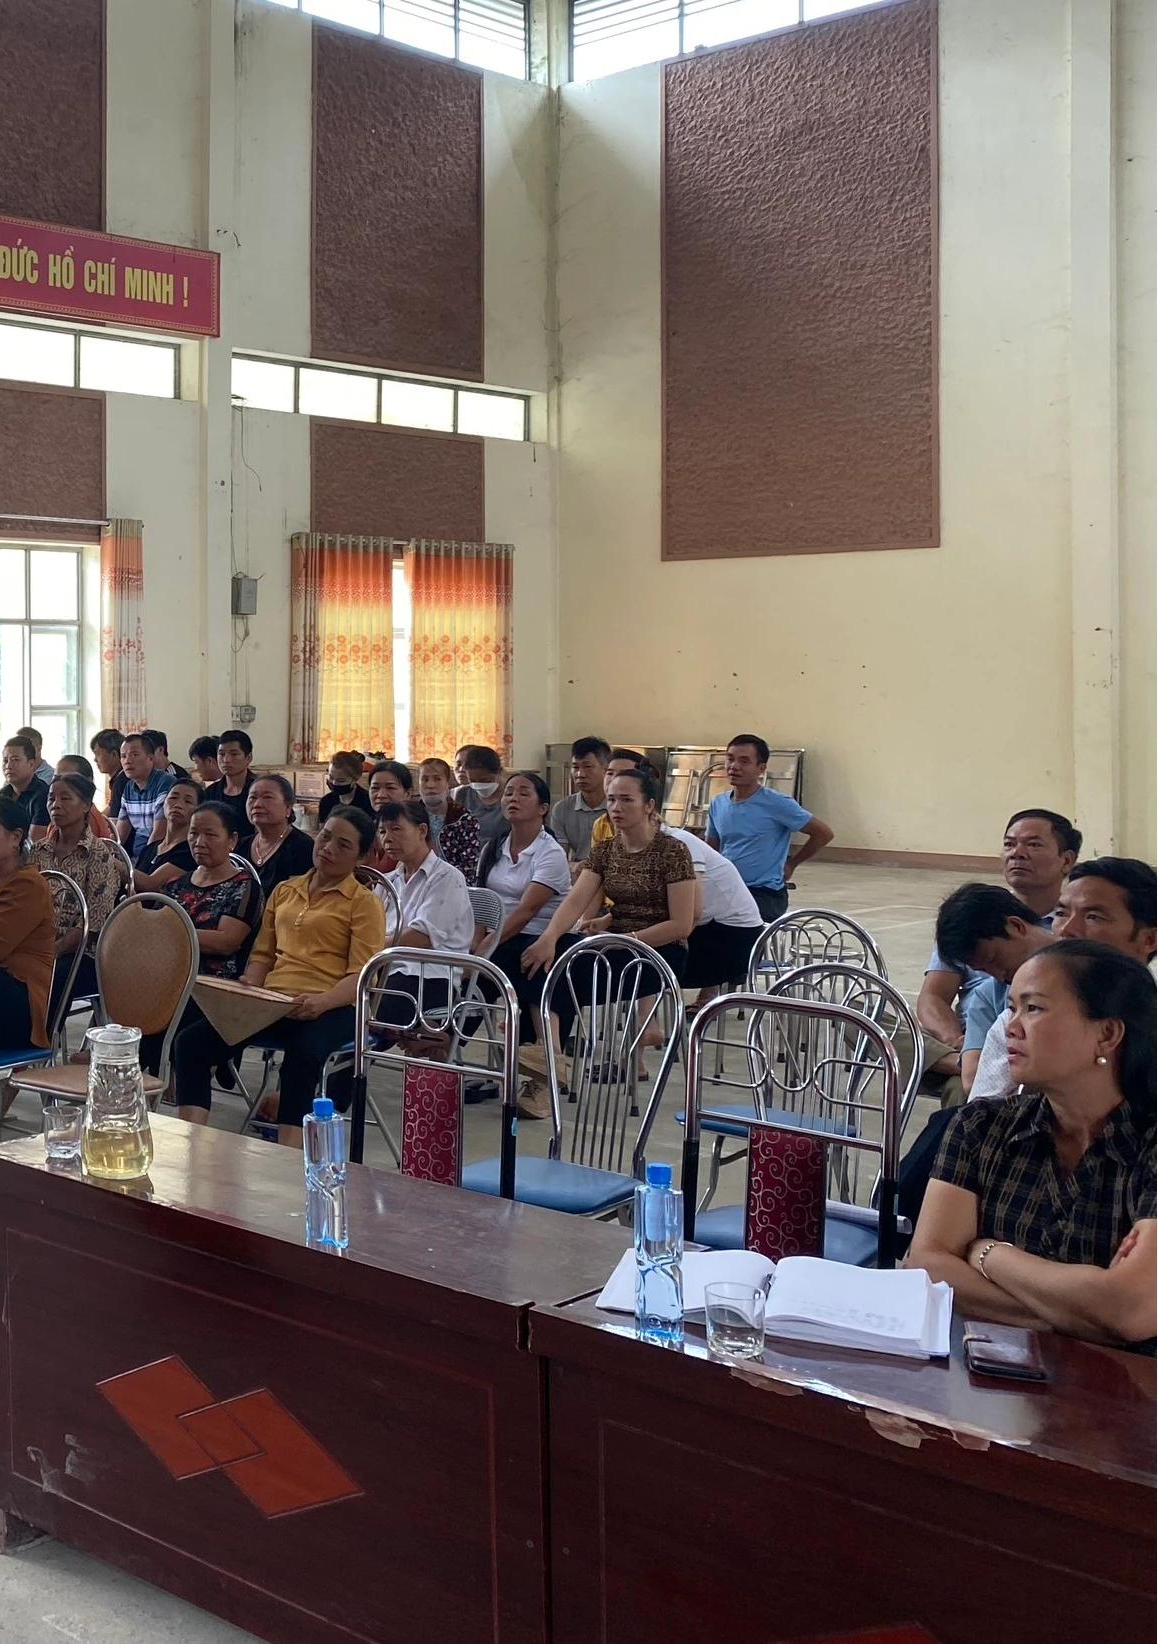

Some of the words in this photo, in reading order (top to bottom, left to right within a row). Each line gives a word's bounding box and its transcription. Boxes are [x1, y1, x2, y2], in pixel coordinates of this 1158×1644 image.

[48, 245, 75, 290] HỒ
[84, 257, 116, 296] CHÍ
[124, 266, 174, 305] MINH
[183, 276, 189, 308] !
